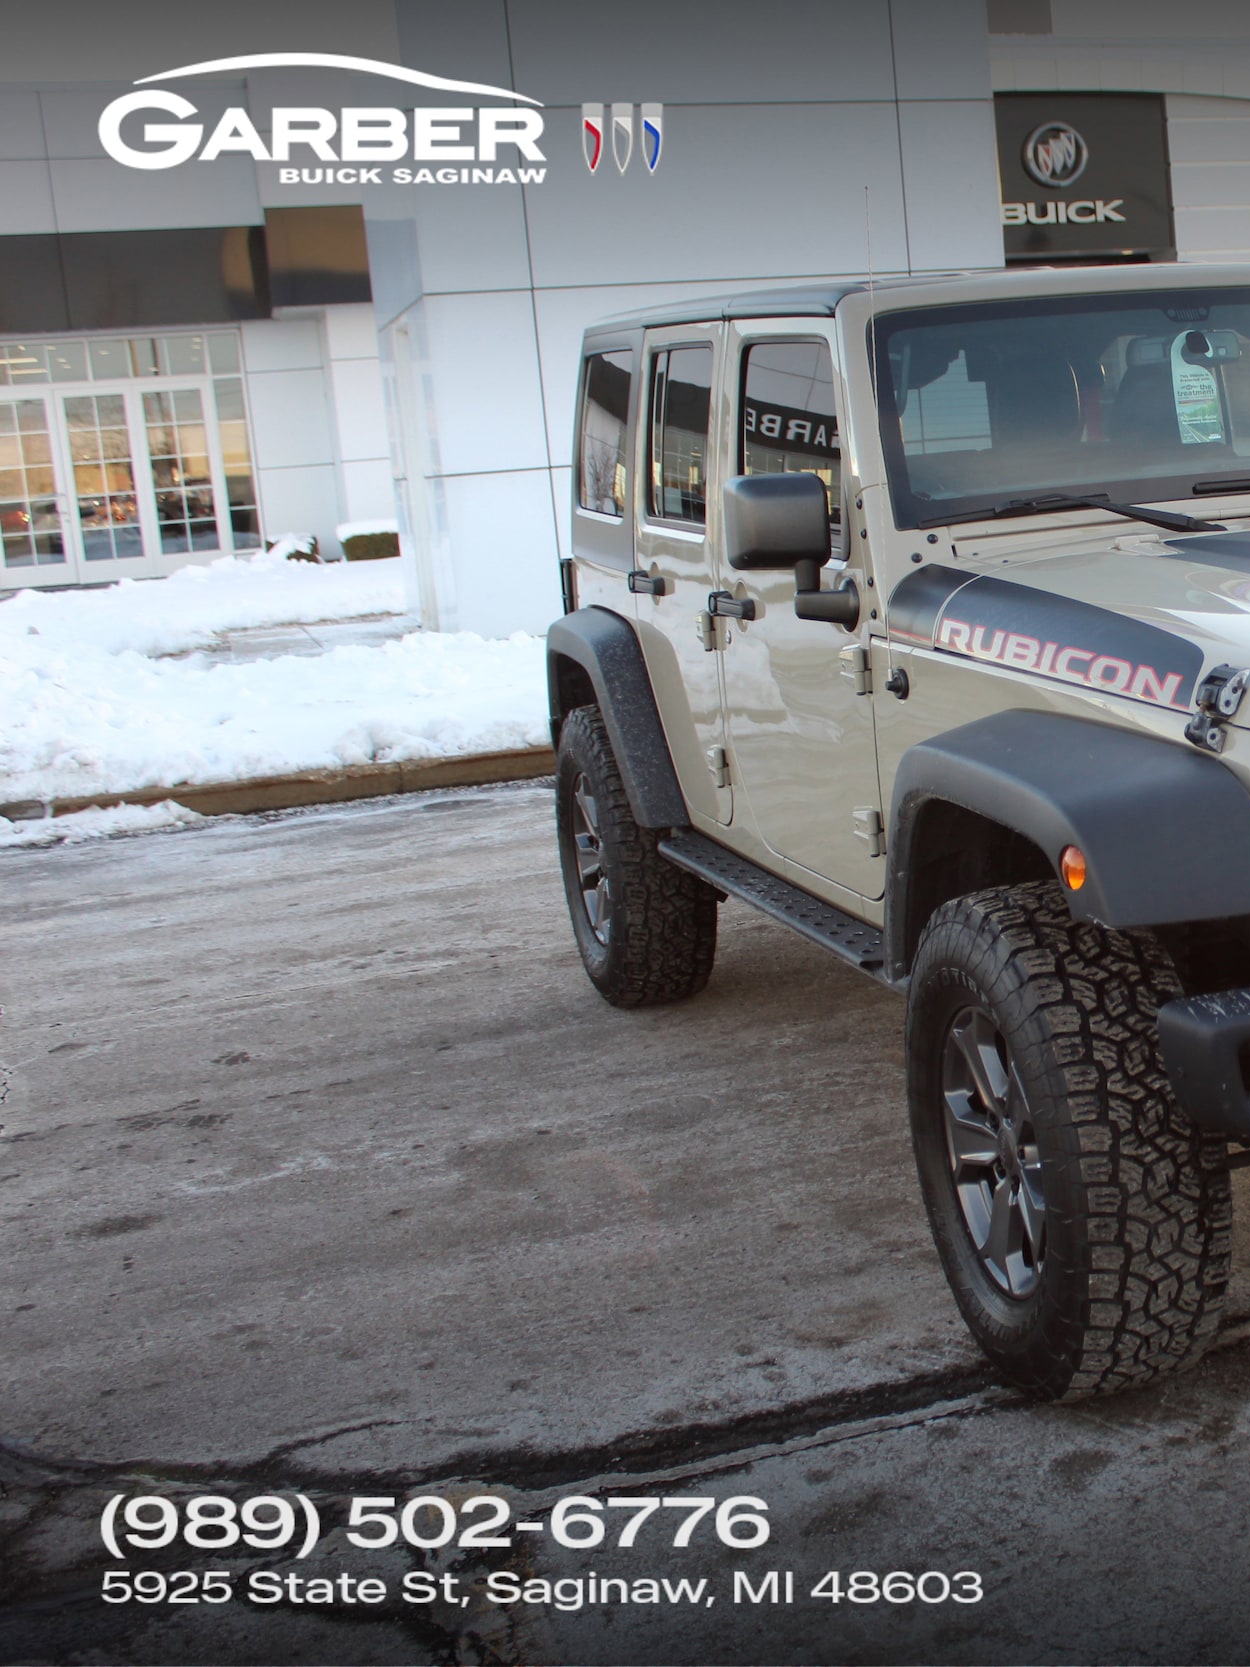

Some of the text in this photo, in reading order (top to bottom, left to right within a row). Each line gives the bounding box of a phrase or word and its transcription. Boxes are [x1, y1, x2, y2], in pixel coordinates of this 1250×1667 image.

[1001, 199, 1127, 226] BUICK
[1177, 389, 1215, 397] treatment
[940, 618, 1188, 704] RUBICON
